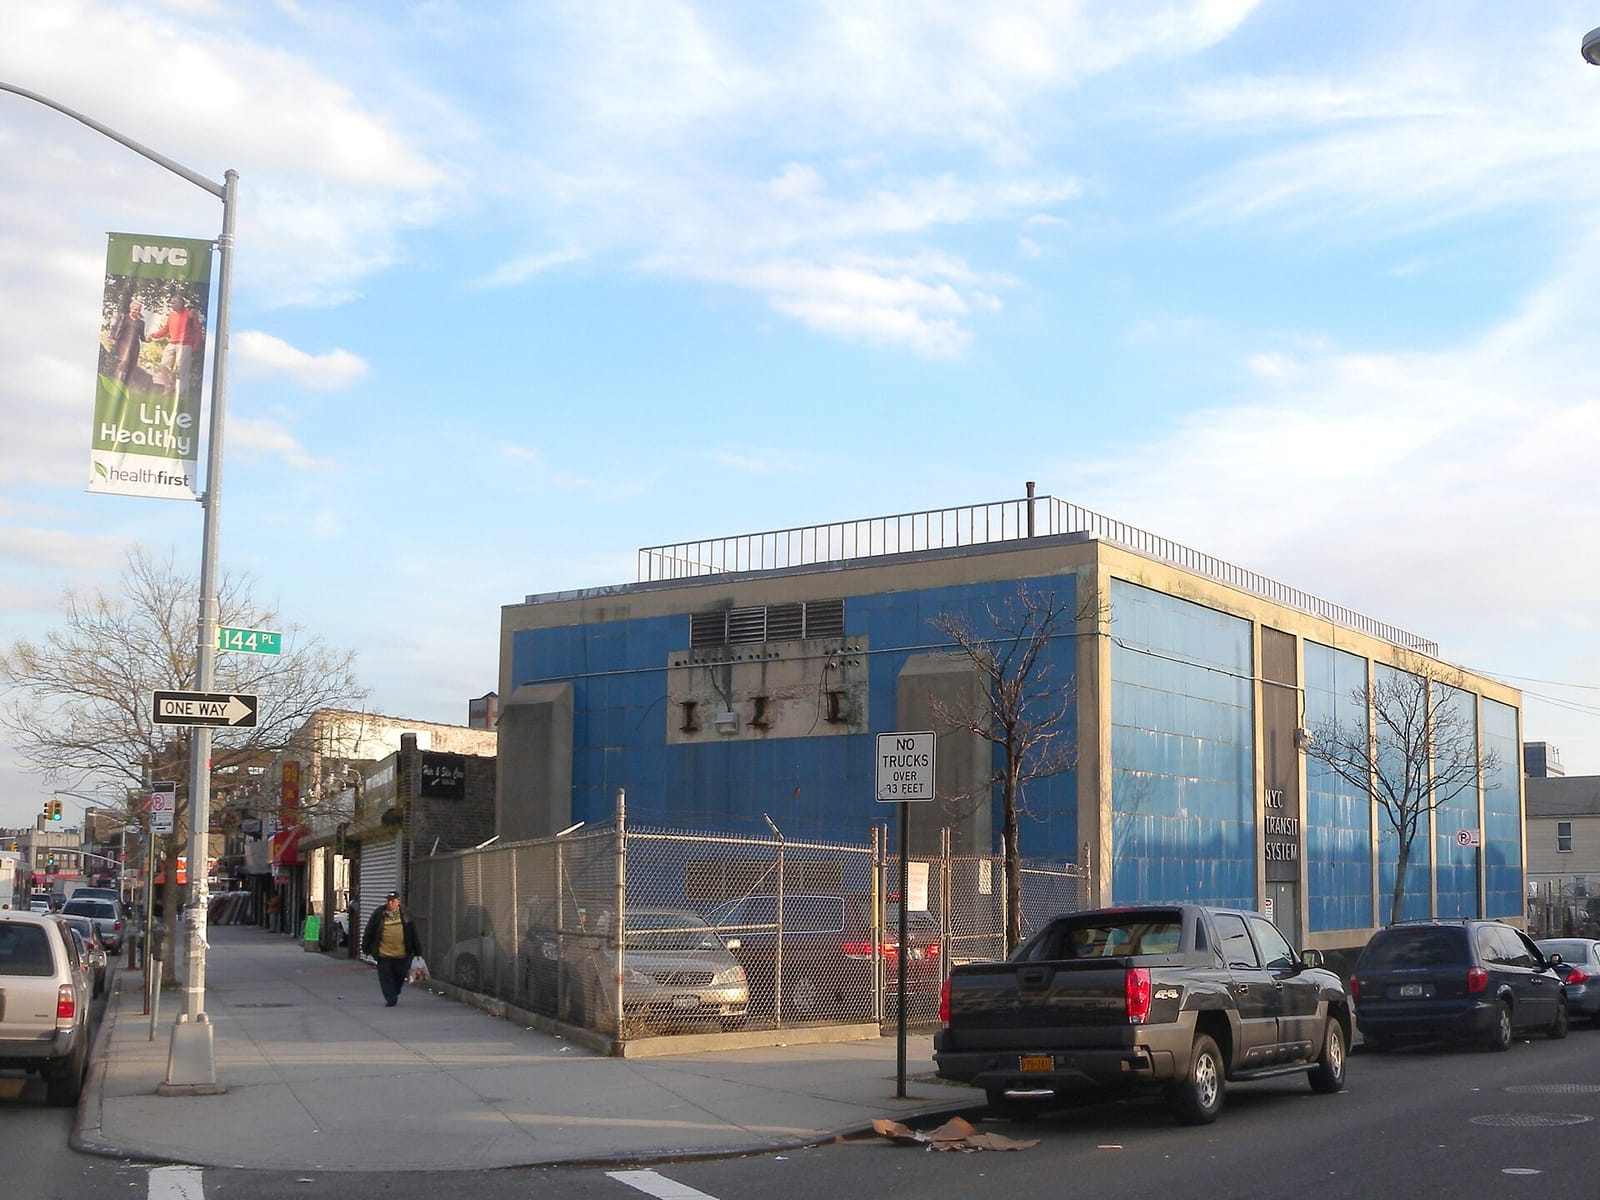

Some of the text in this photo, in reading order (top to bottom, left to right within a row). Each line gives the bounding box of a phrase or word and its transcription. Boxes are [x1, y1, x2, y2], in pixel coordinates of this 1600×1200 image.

[132, 245, 187, 266] NYC
[139, 403, 193, 429] Live
[100, 422, 191, 455] Healthy
[110, 465, 190, 487] healthfirst
[224, 629, 274, 651] 144 PL
[165, 701, 228, 717] ONE WAY
[896, 738, 915, 751] NO
[882, 754, 929, 768] TRUCKS
[893, 771, 917, 781] OVER
[901, 783, 924, 794] FEET
[1264, 789, 1284, 809] NYC
[1265, 815, 1298, 836] TRANSIT
[1265, 842, 1297, 861] SYSTEM
